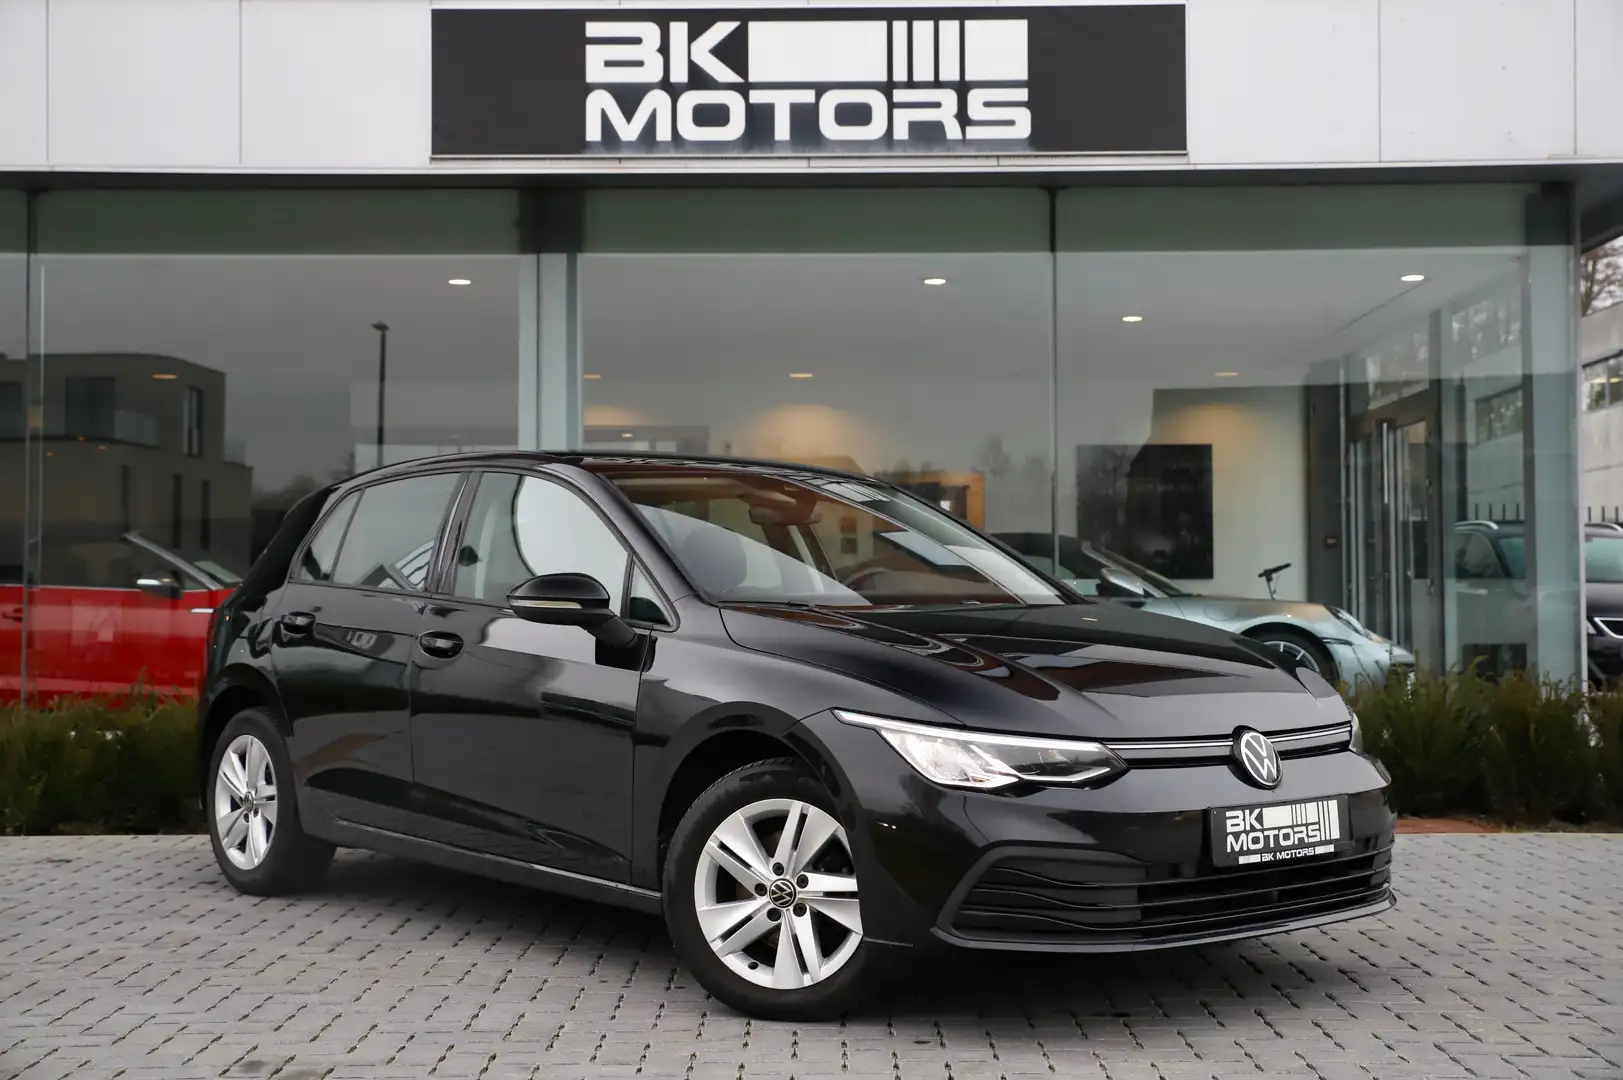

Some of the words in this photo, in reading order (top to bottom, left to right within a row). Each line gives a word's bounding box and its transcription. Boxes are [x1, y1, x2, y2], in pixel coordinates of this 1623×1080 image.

[585, 21, 745, 83] BK
[585, 88, 1032, 142] MOTORS
[1225, 808, 1263, 833] BK
[1226, 824, 1321, 853] MOTORS
[1261, 852, 1275, 862] BK
[1276, 847, 1315, 860] MOTORS
